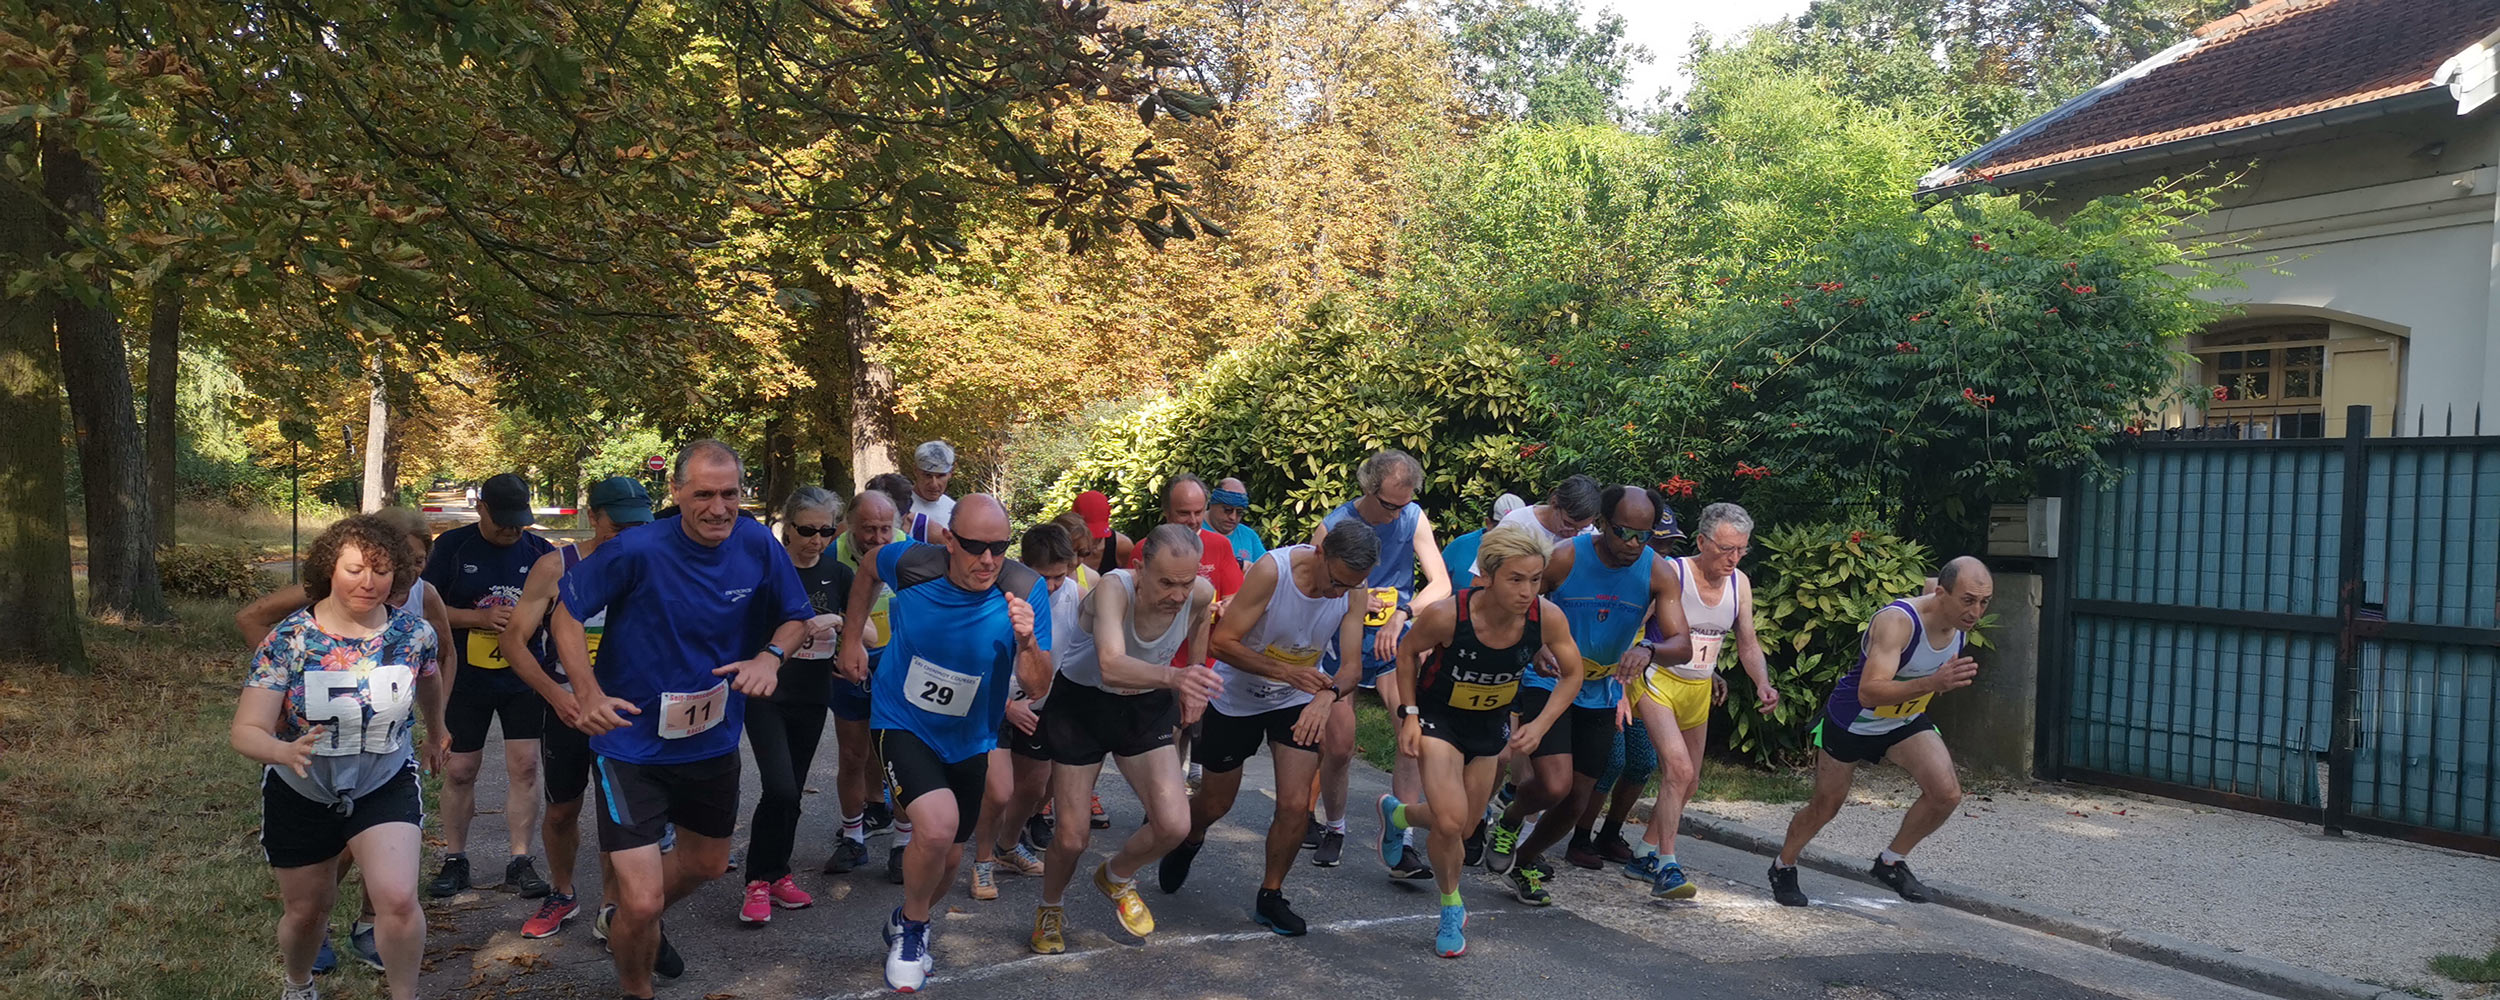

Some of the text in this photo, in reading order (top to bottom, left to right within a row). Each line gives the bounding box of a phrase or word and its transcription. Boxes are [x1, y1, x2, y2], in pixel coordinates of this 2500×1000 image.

[1700, 645, 1707, 661] 1
[920, 681, 954, 706] 29
[1469, 695, 1499, 707] 15
[304, 665, 414, 756] 58
[685, 701, 711, 725] 11
[1894, 701, 1919, 714] 17
